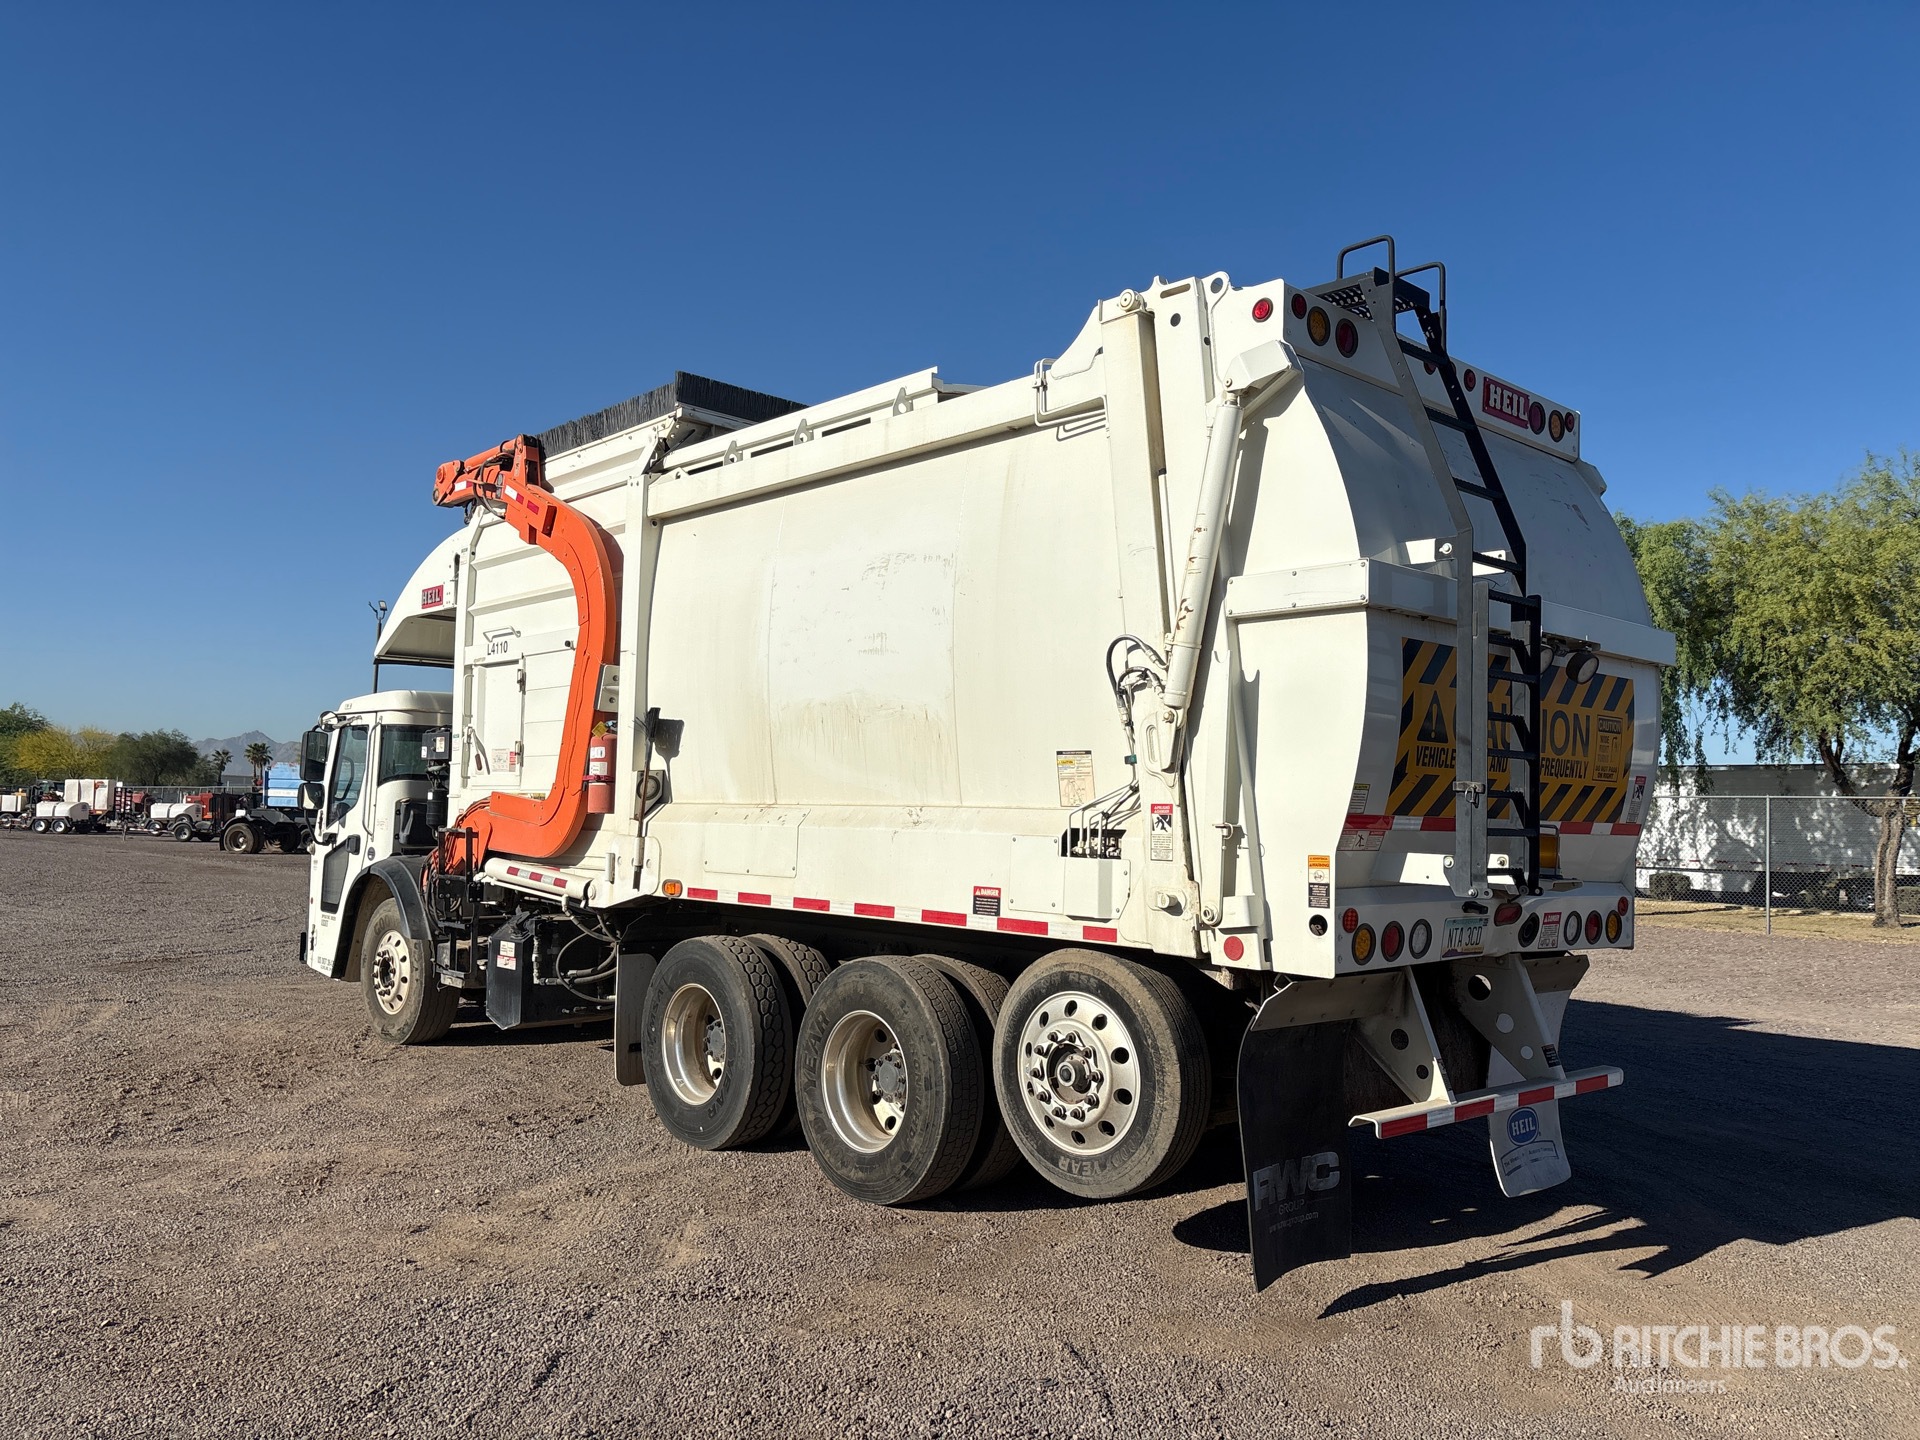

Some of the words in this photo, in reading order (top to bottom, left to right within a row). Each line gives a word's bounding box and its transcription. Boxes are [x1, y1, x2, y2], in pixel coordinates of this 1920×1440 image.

[1489, 383, 1528, 421] HEIL
[422, 588, 441, 606] HEIL
[487, 640, 509, 656] L4110
[1489, 757, 1509, 773] AND
[1540, 756, 1590, 779] FREQUENTLY
[1447, 927, 1463, 949] NTA
[1465, 926, 1483, 947] 3CD
[1511, 1116, 1537, 1137] HEIL
[1278, 1198, 1306, 1216] GROUP
